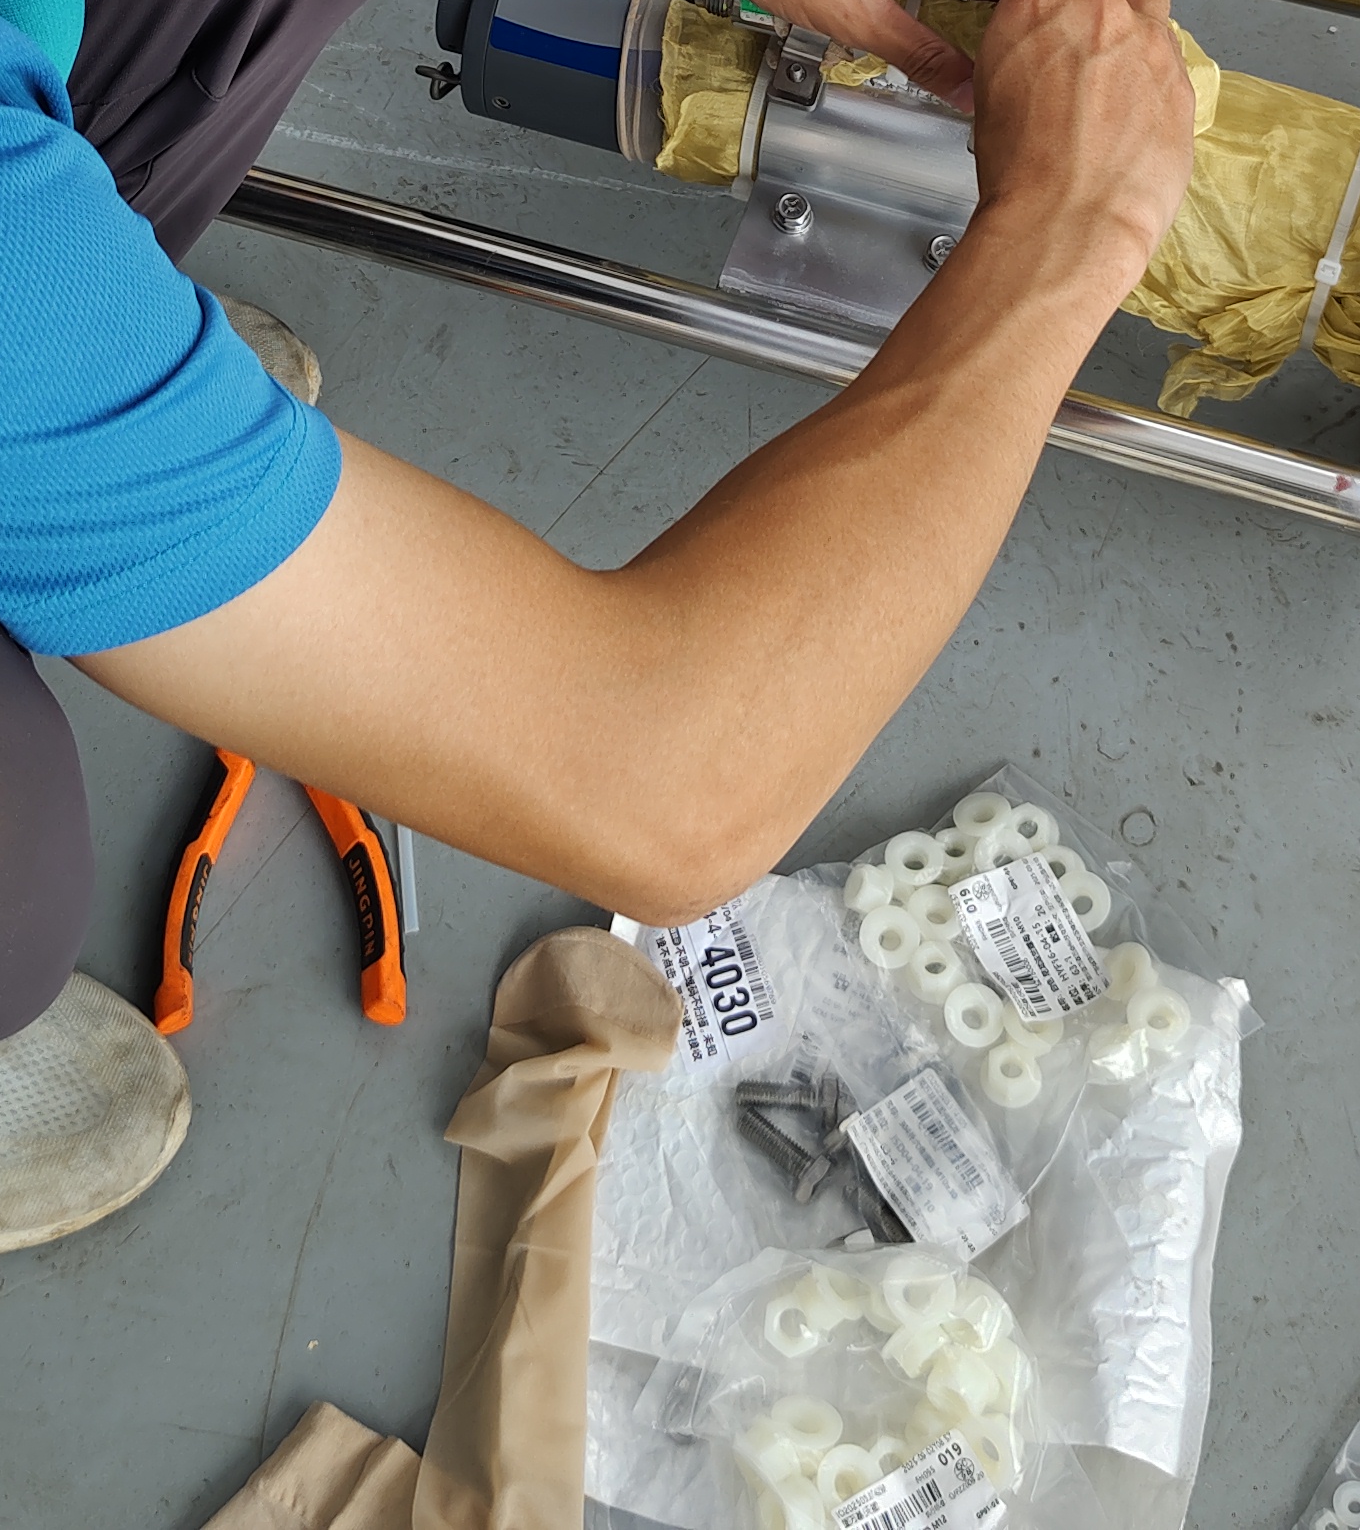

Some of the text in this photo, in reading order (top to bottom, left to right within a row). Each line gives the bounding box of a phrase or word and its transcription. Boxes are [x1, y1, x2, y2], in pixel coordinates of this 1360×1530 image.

[349, 858, 375, 957] JINGPIN
[959, 888, 977, 913] 019
[701, 946, 757, 1036] 4030
[937, 1442, 962, 1466] 019
